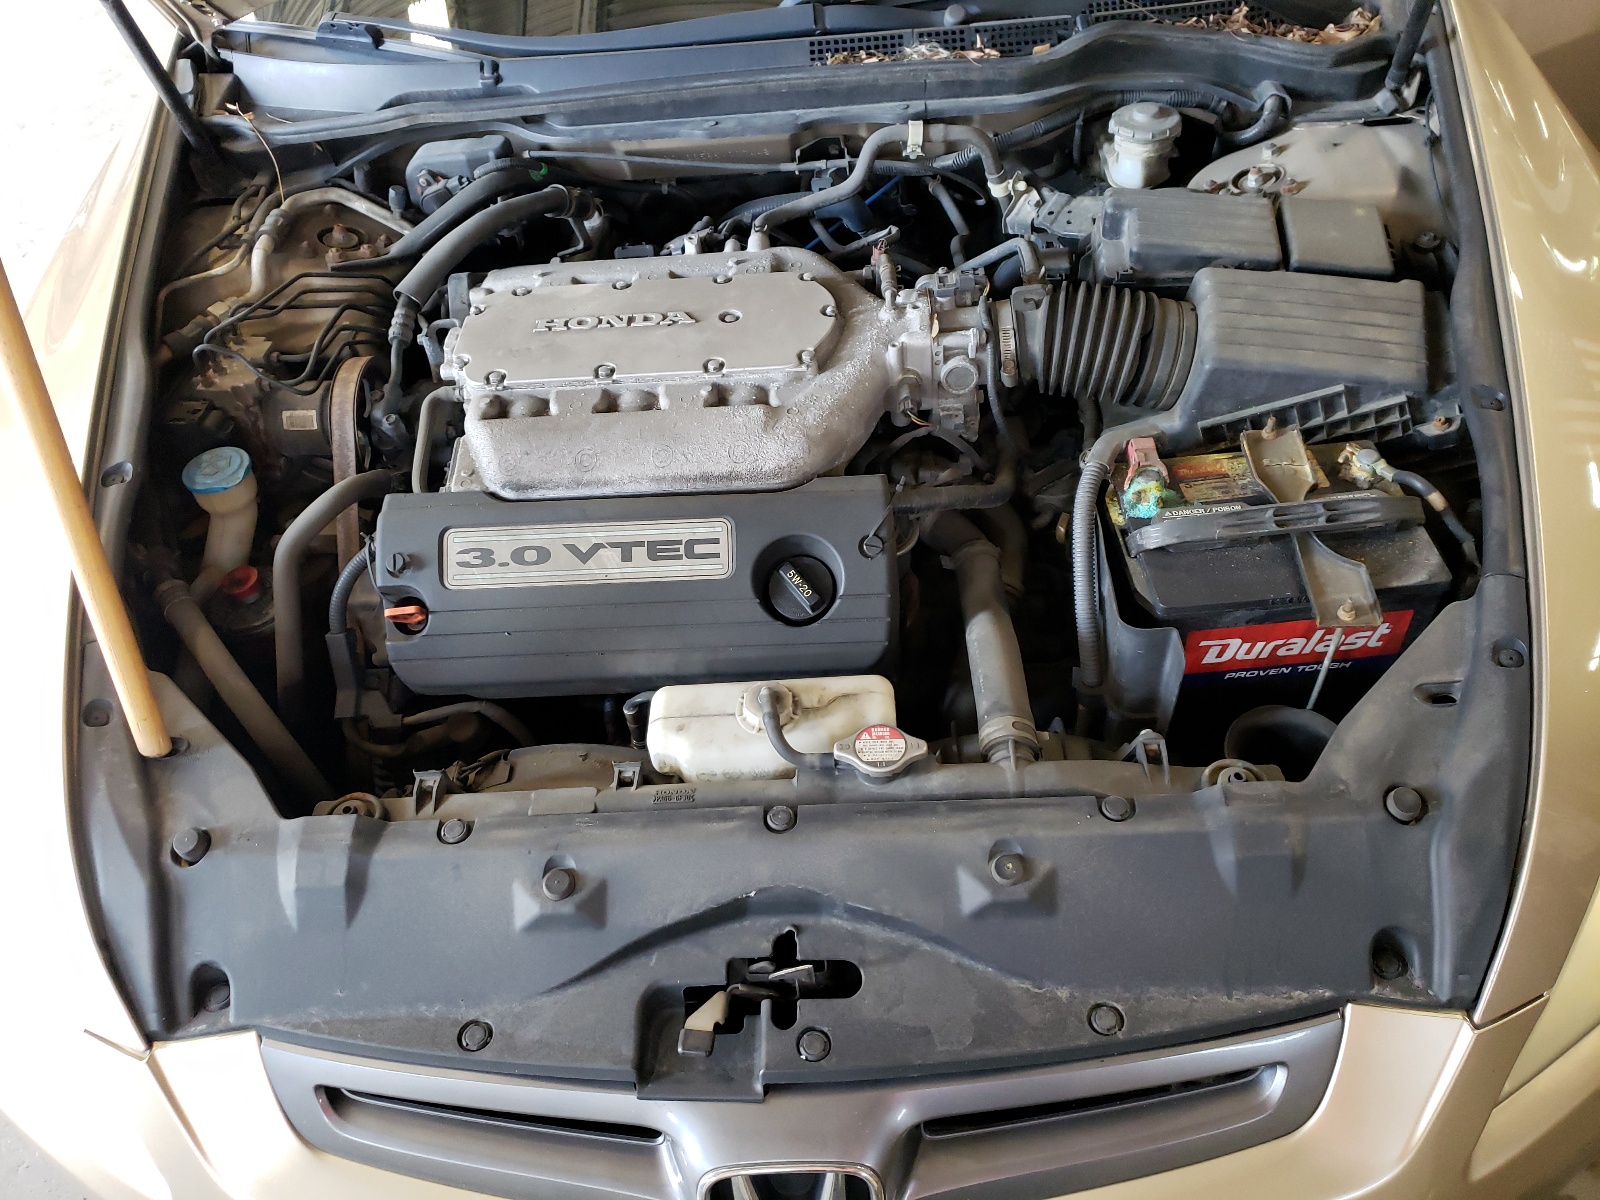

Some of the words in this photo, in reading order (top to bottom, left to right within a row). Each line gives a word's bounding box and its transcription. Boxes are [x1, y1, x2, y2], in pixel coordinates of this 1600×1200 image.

[532, 310, 696, 333] HONDA
[1172, 508, 1205, 516] DANGER
[1212, 505, 1242, 513] POISON
[455, 545, 551, 568] 3.0
[562, 538, 721, 565] VTEC
[786, 569, 812, 597] 5W-20
[1198, 622, 1394, 665] Duralast
[1223, 666, 1293, 680] PROVEN
